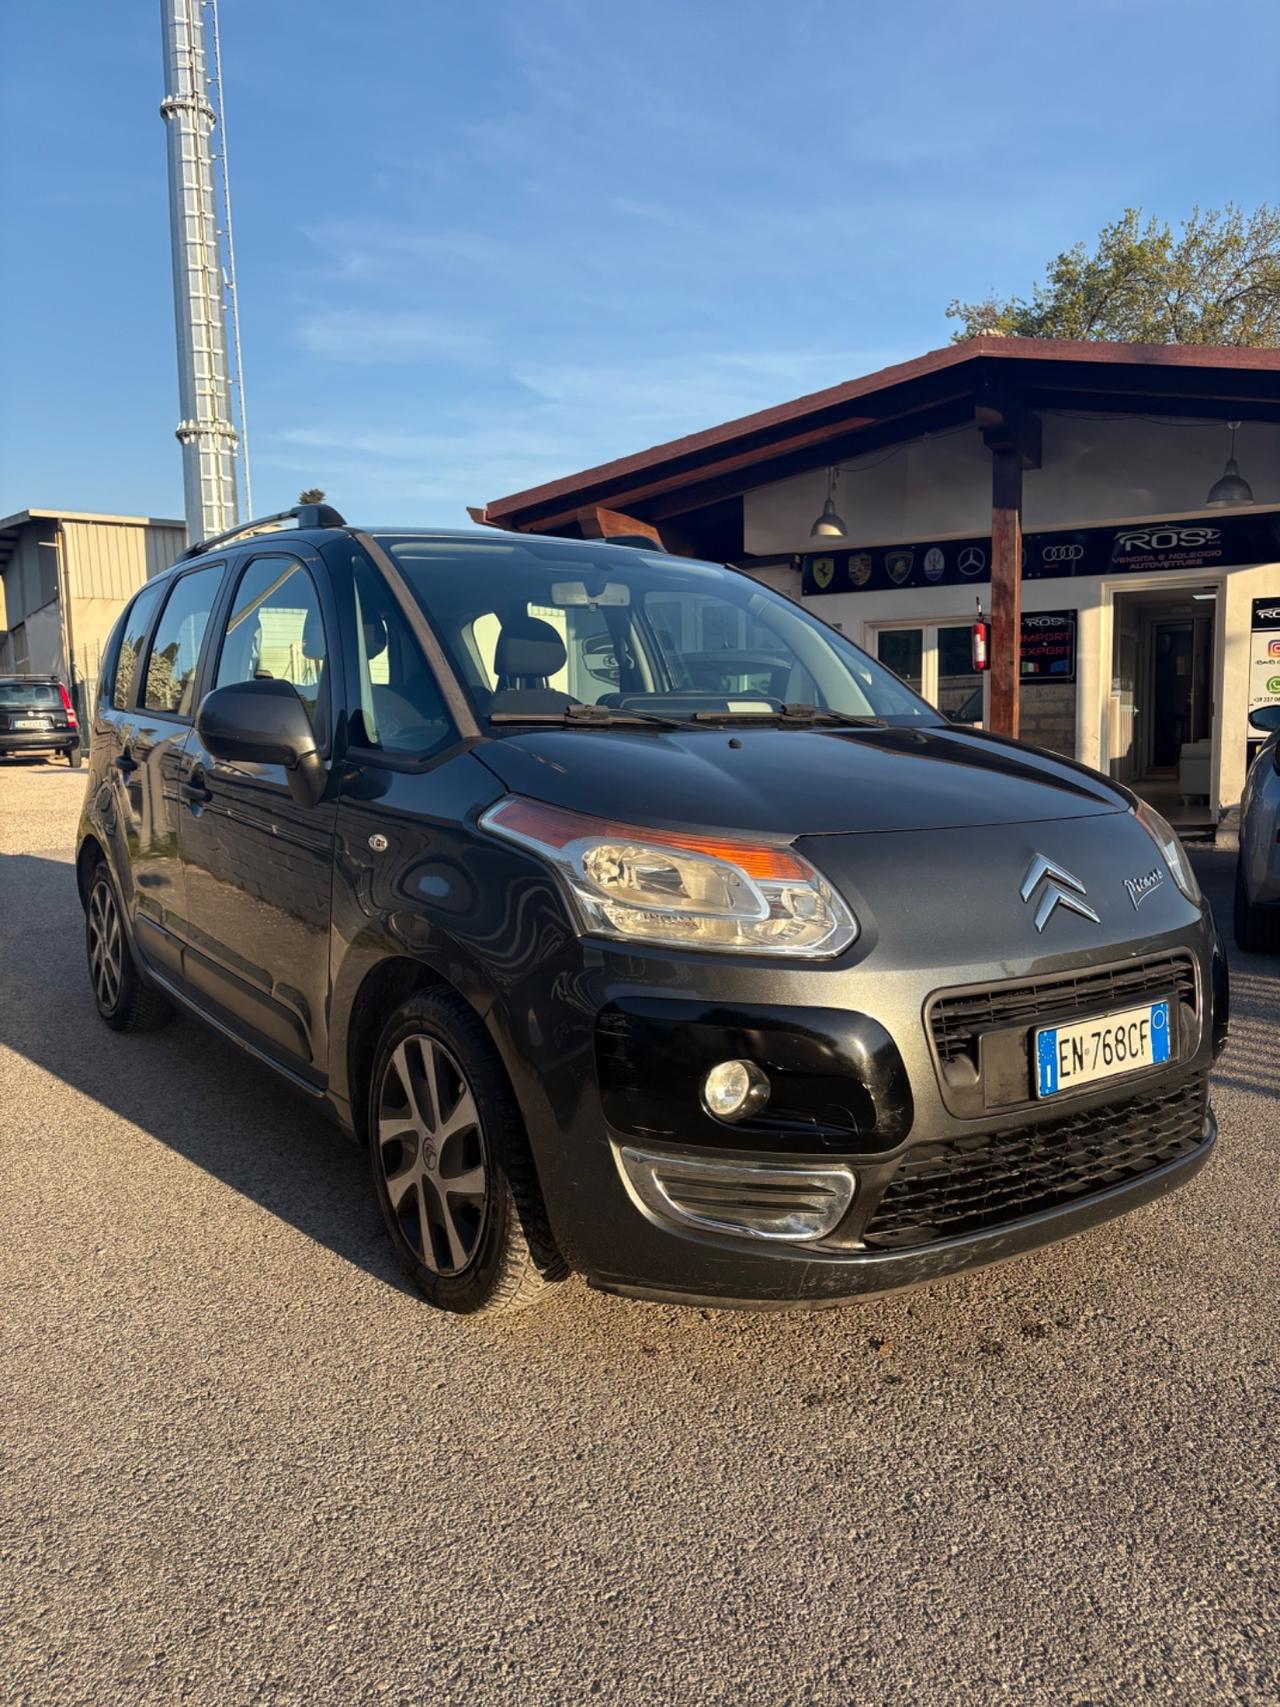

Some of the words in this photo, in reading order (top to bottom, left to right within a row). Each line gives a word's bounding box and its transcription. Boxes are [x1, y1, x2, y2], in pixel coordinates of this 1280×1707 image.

[1112, 554, 1154, 564] VENDITA
[1158, 553, 1165, 561] E
[1168, 549, 1222, 560] NOLEGGIO
[1129, 558, 1203, 570] AUTOVETTURE
[1019, 646, 1072, 656] EXPORT
